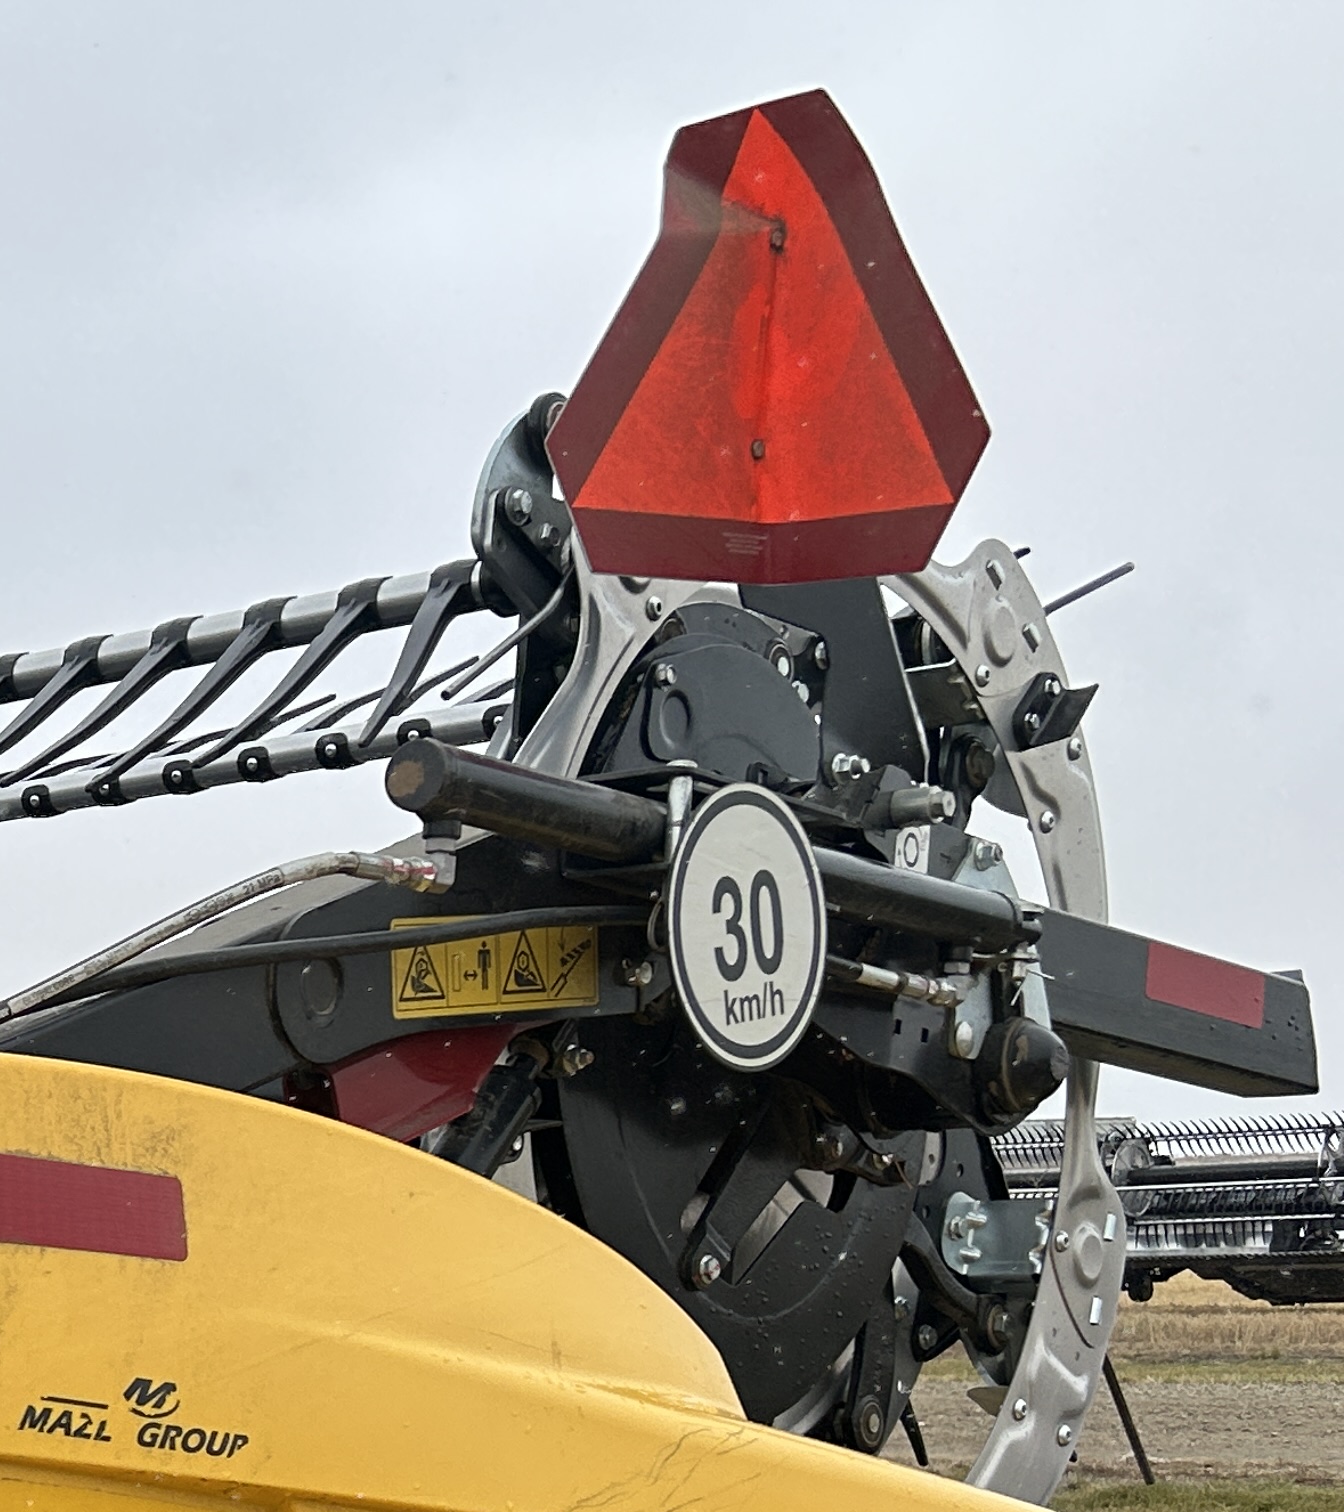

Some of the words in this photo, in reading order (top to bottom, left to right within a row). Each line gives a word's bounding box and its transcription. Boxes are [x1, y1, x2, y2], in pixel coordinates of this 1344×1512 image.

[712, 869, 784, 982] 30
[724, 981, 785, 1026] km/h
[137, 1422, 249, 1459] GROUP
